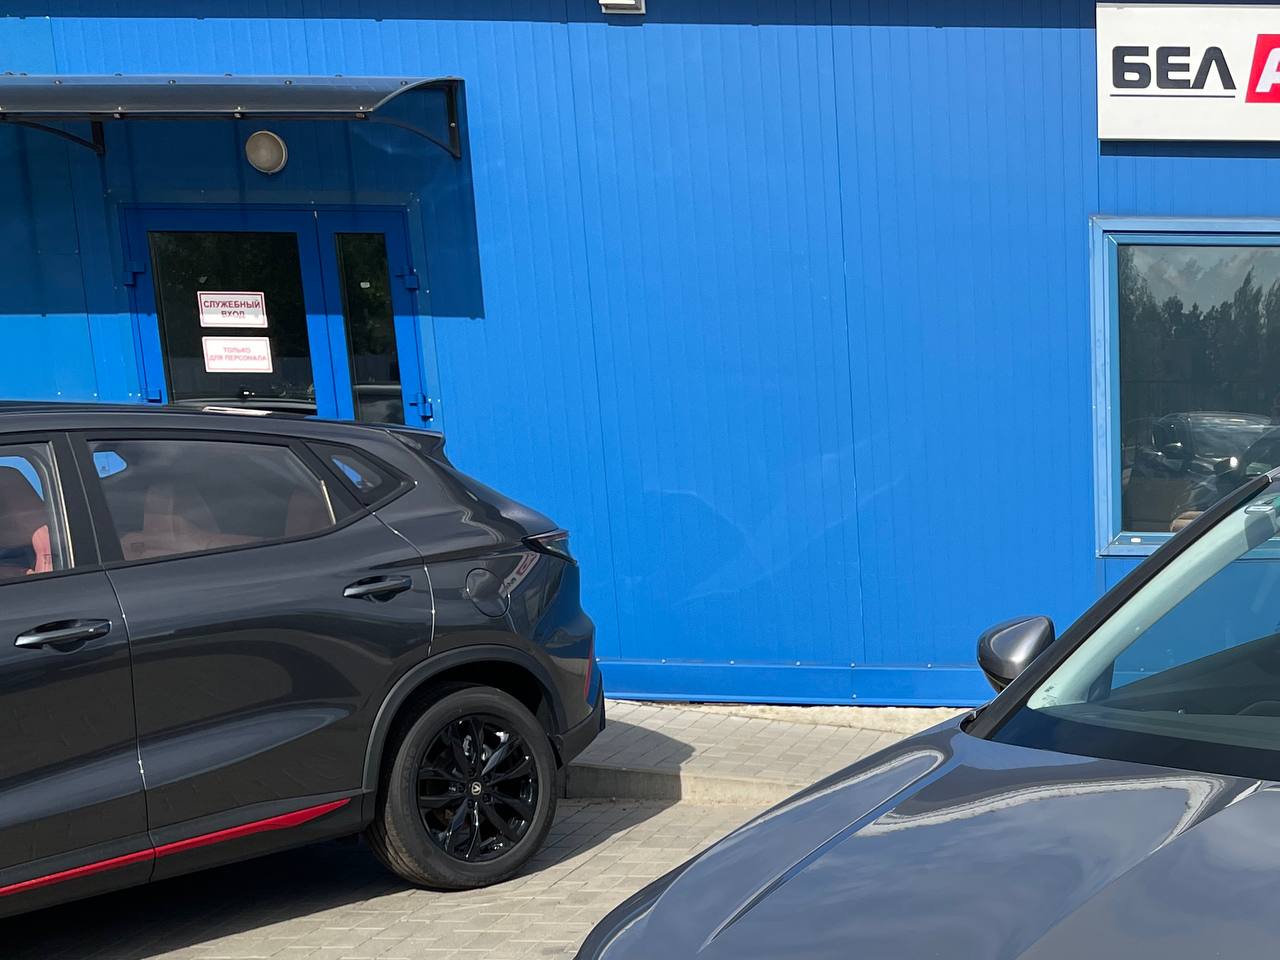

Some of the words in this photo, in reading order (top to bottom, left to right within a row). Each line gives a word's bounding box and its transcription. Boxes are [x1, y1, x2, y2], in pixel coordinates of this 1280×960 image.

[1111, 46, 1237, 90] БЕЛ
[203, 300, 261, 309] СЛУЖЕБНЫЙ
[221, 311, 245, 319] ВХОД
